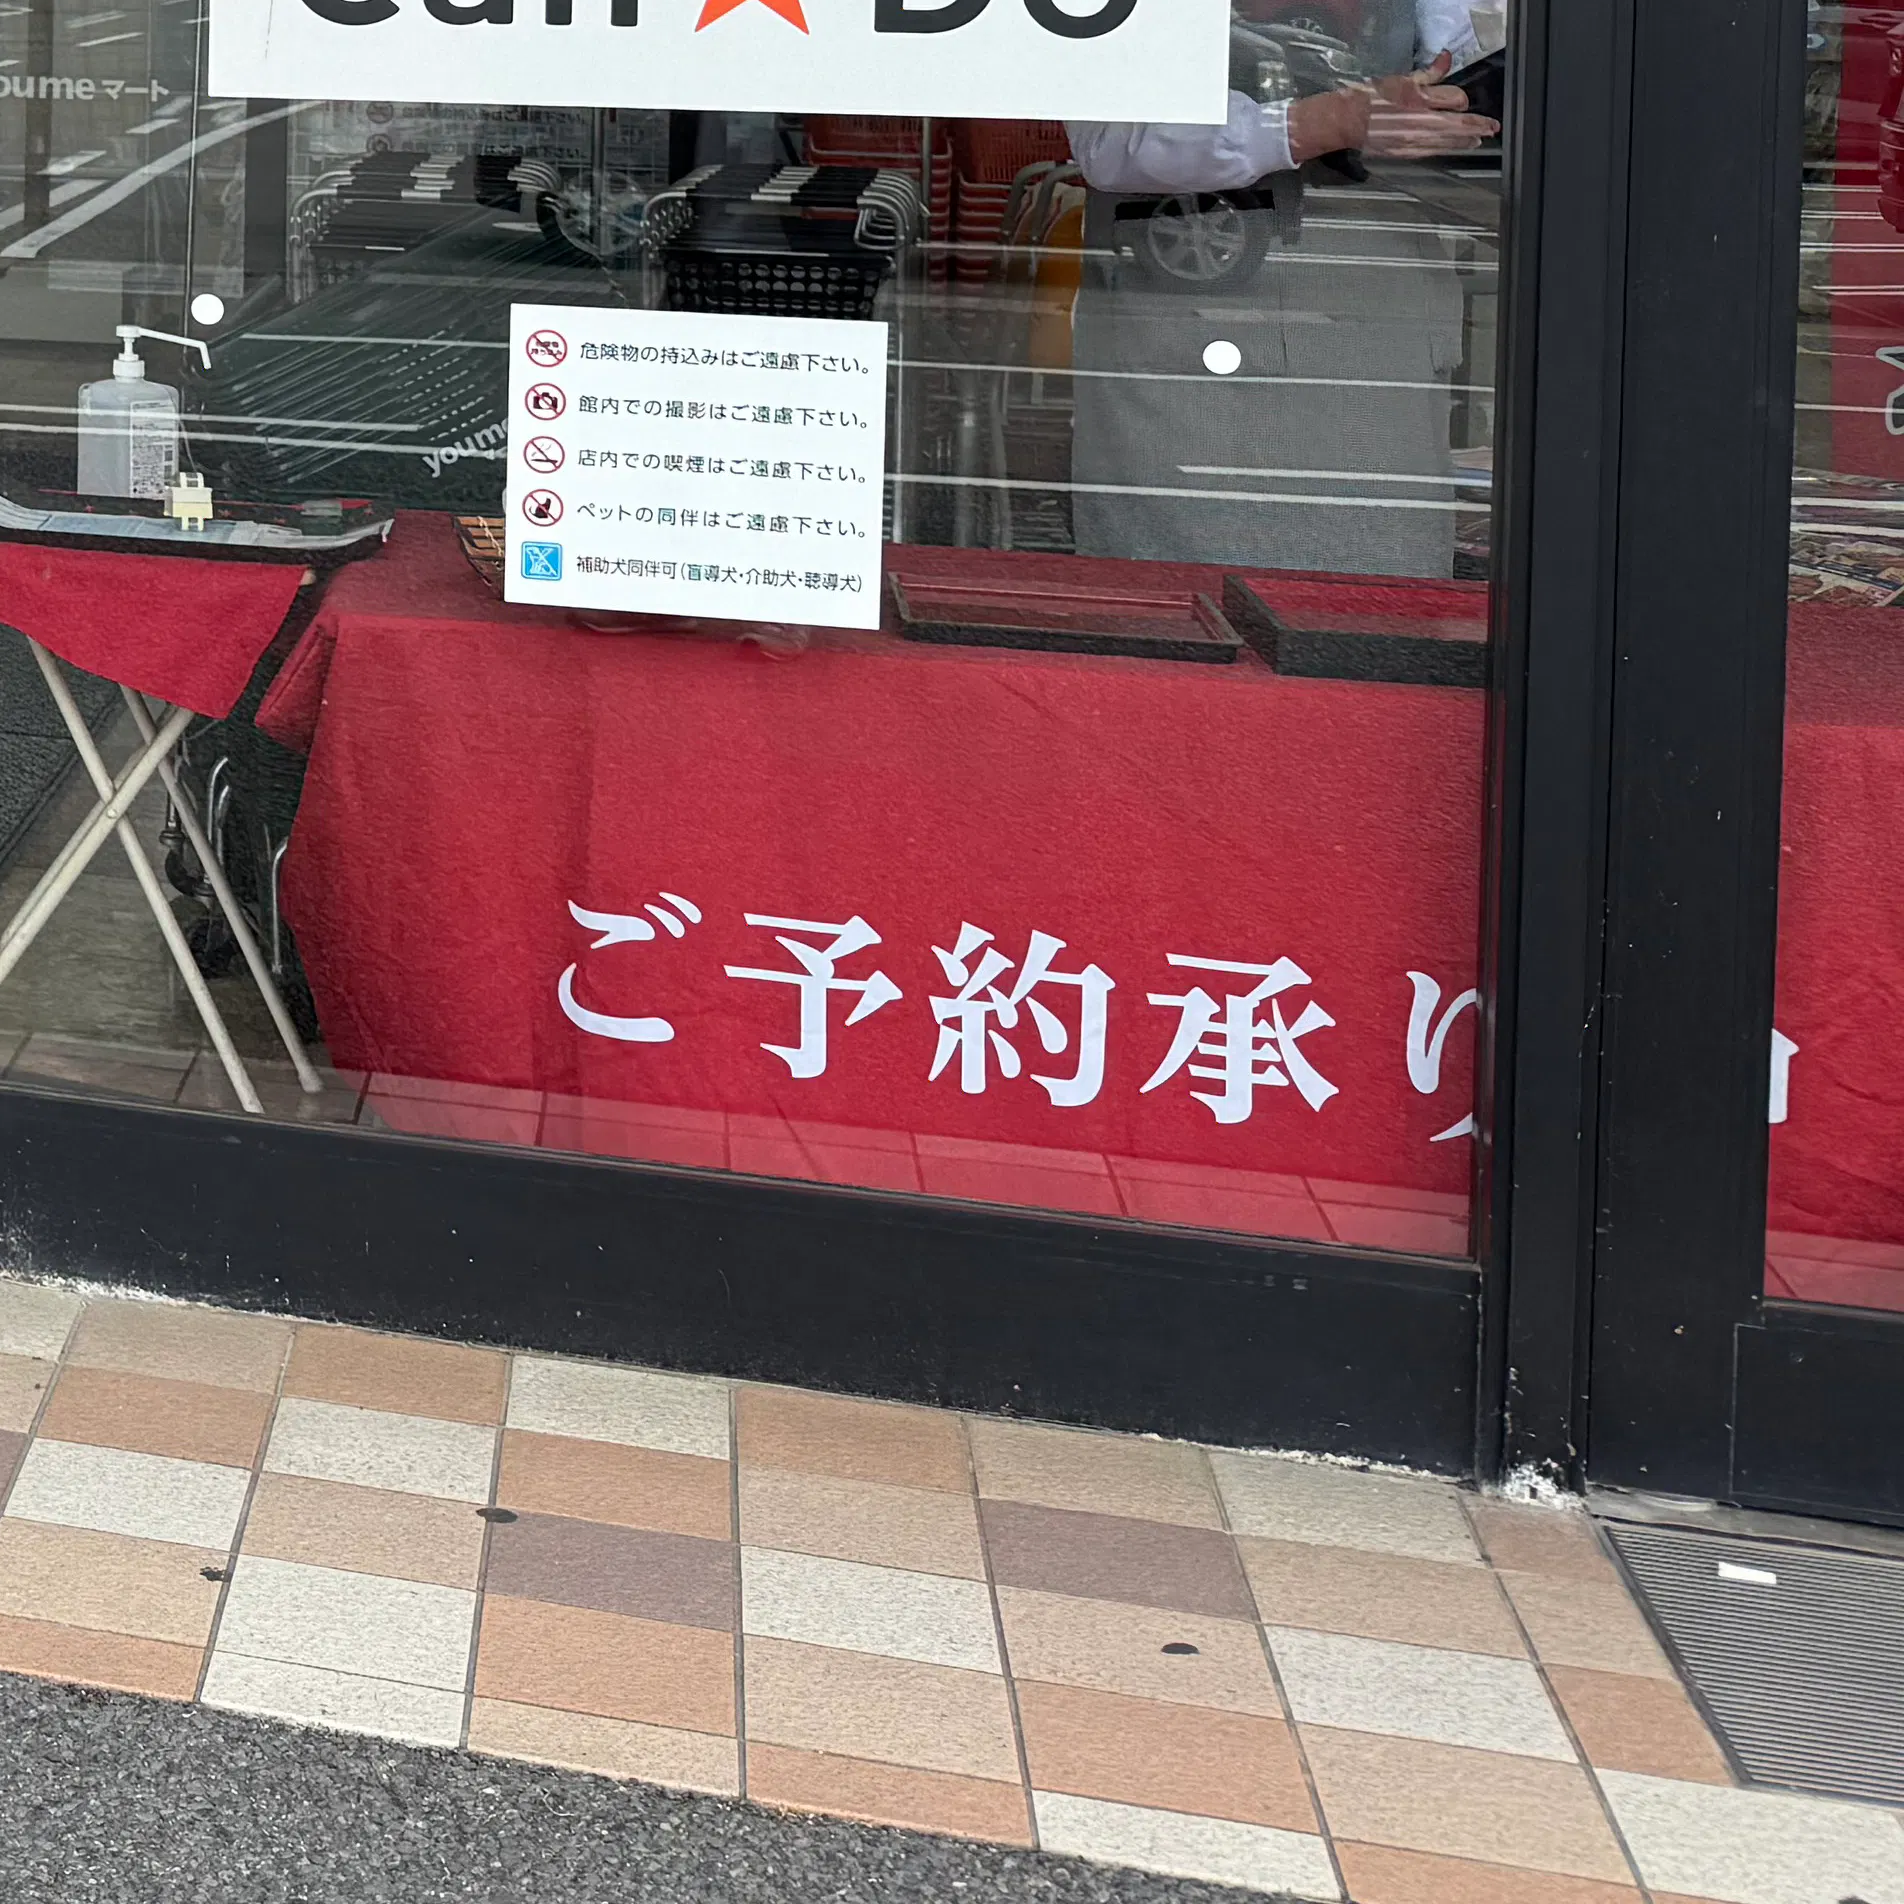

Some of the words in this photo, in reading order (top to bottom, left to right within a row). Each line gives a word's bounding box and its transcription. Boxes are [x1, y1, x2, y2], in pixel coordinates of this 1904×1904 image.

[103, 78, 170, 102] マート
[579, 341, 871, 375] 危険物の持込みはご遠慮下さい。
[578, 395, 868, 429] 館内での撮影はご遠慮下さい。
[577, 449, 867, 484] 店内での喫煙はご遠慮下さい。
[577, 503, 866, 539] ペットの同伴はご遠慮下さい。
